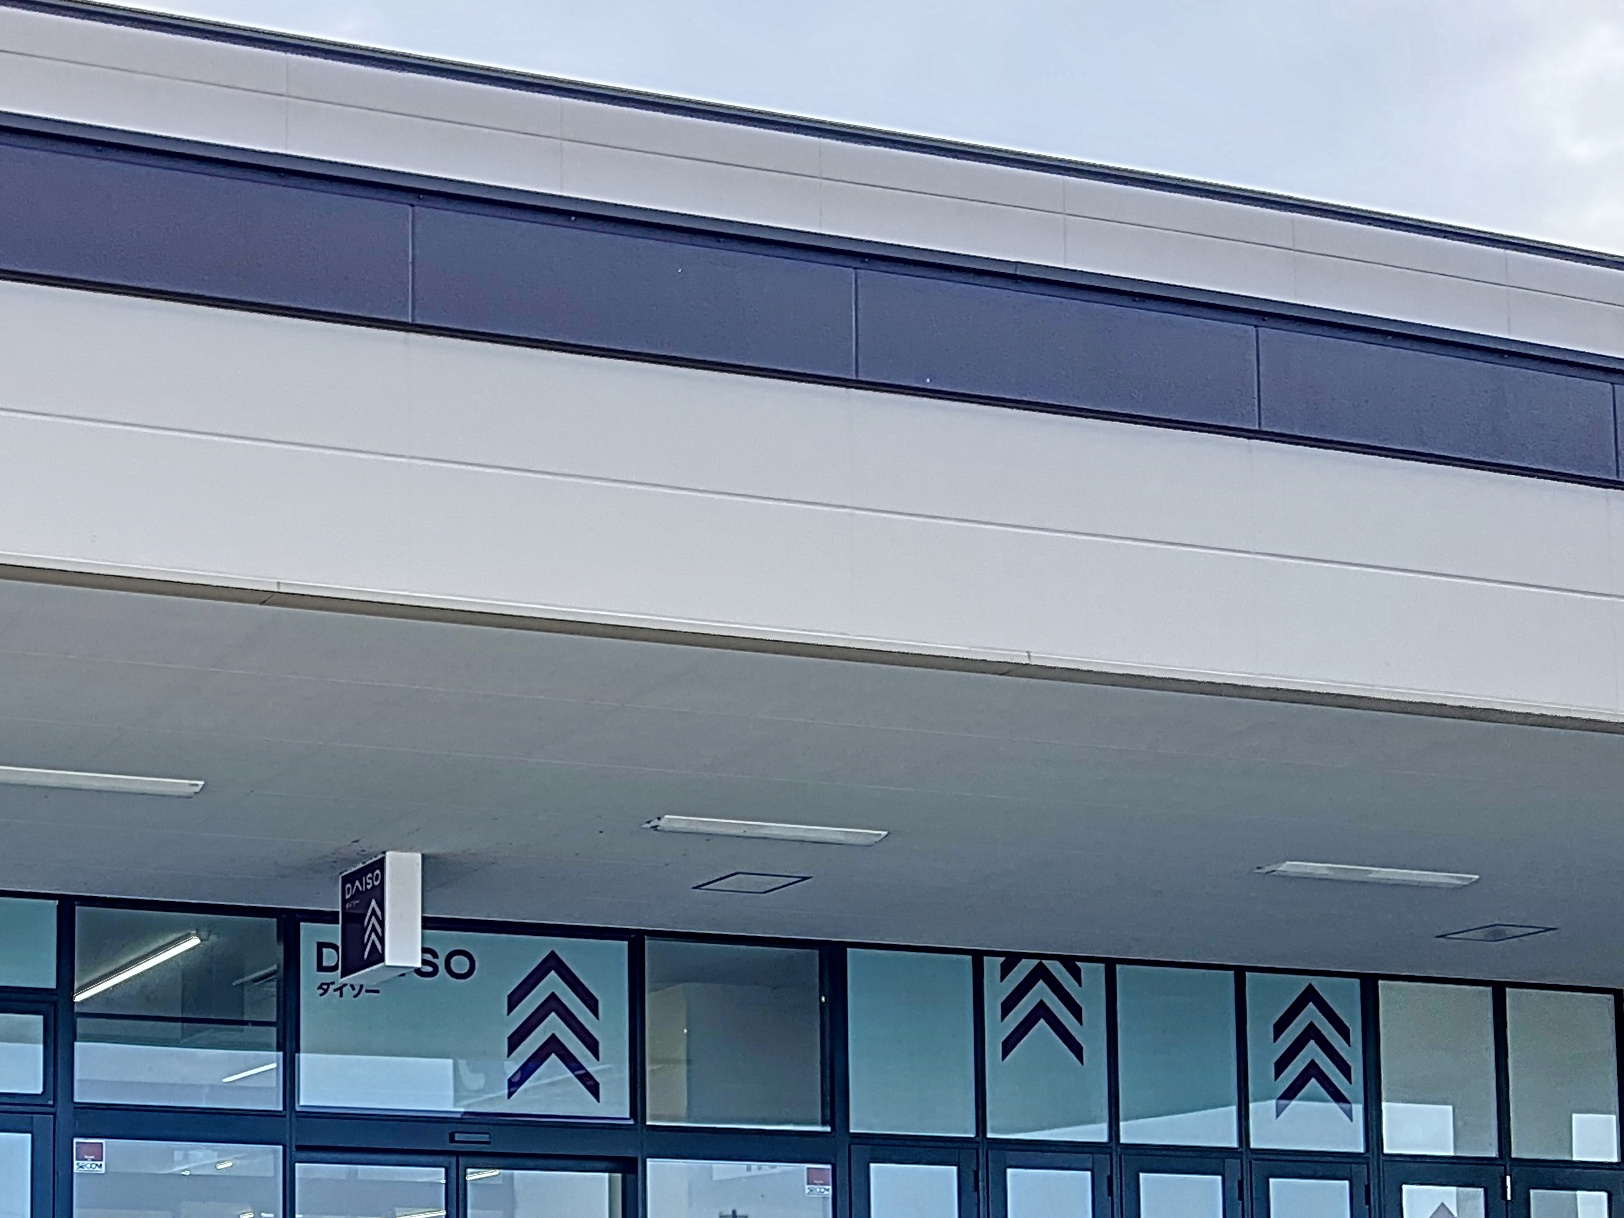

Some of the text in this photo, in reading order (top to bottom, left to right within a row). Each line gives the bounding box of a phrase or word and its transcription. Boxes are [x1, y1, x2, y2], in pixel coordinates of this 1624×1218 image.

[345, 869, 381, 899] DAISO
[316, 941, 476, 980] DSO
[316, 981, 381, 999] ダイソー
[76, 1162, 103, 1170] SECOM
